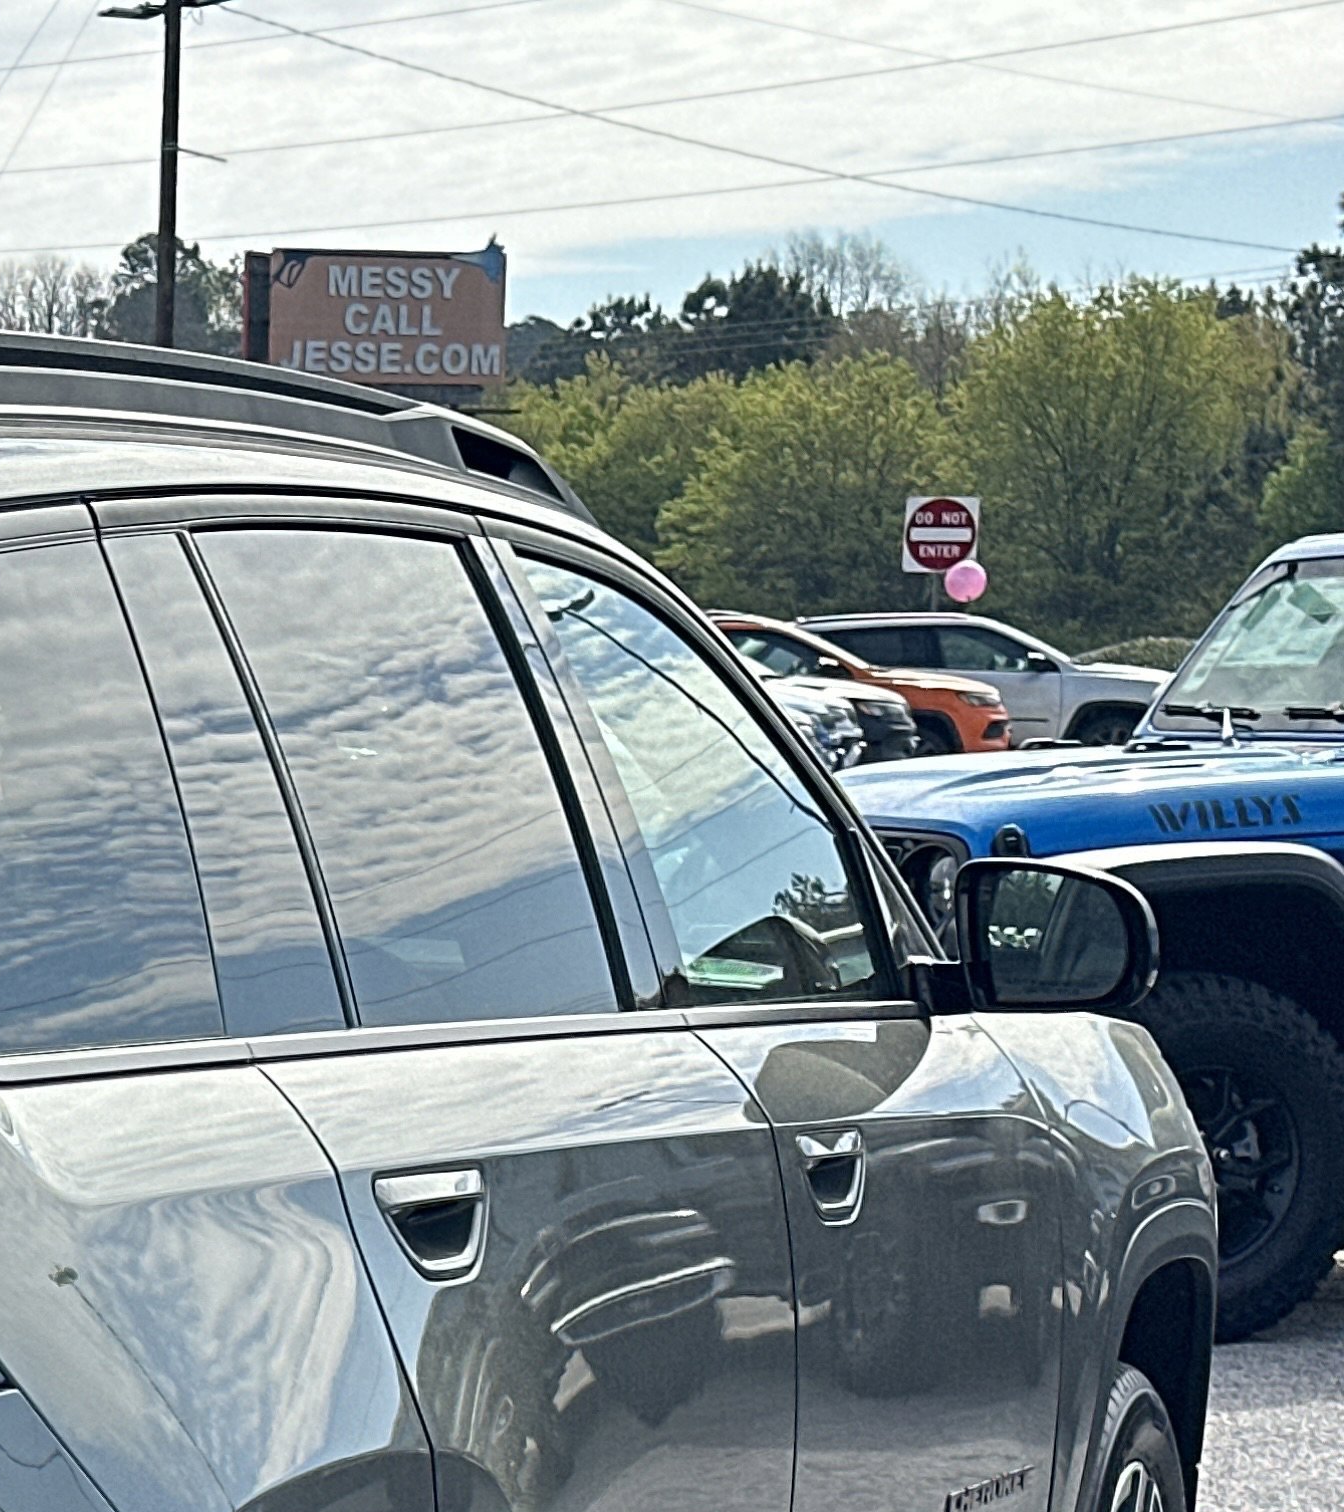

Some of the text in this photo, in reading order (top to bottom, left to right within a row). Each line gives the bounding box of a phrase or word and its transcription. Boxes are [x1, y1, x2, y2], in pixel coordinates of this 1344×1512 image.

[328, 264, 461, 299] MESSY
[344, 303, 443, 336] CALL
[280, 340, 500, 375] JESSE.COM
[915, 511, 968, 525] DO NOT
[918, 544, 961, 558] ENTER
[1148, 794, 1302, 833] WILLYS
